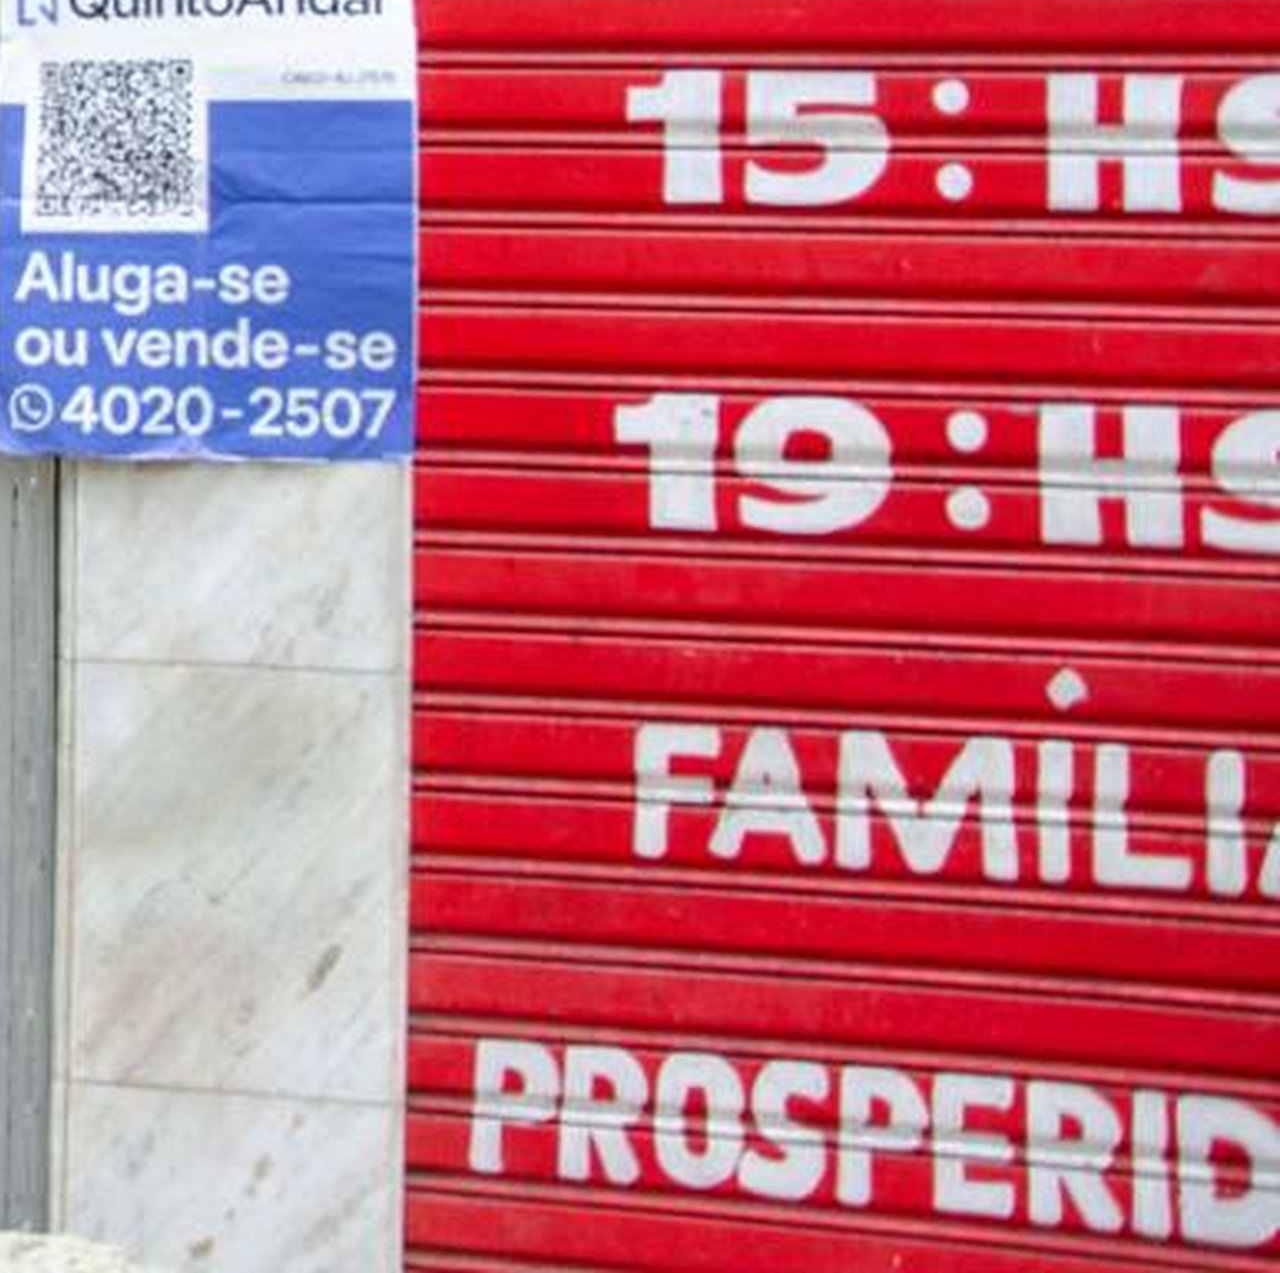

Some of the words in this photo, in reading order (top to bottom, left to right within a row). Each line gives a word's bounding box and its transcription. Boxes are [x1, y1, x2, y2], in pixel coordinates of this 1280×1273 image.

[14, 252, 289, 317] Aluga-se
[14, 330, 88, 367] ou
[102, 319, 396, 369] vende-se
[61, 385, 396, 438] 4020-2507
